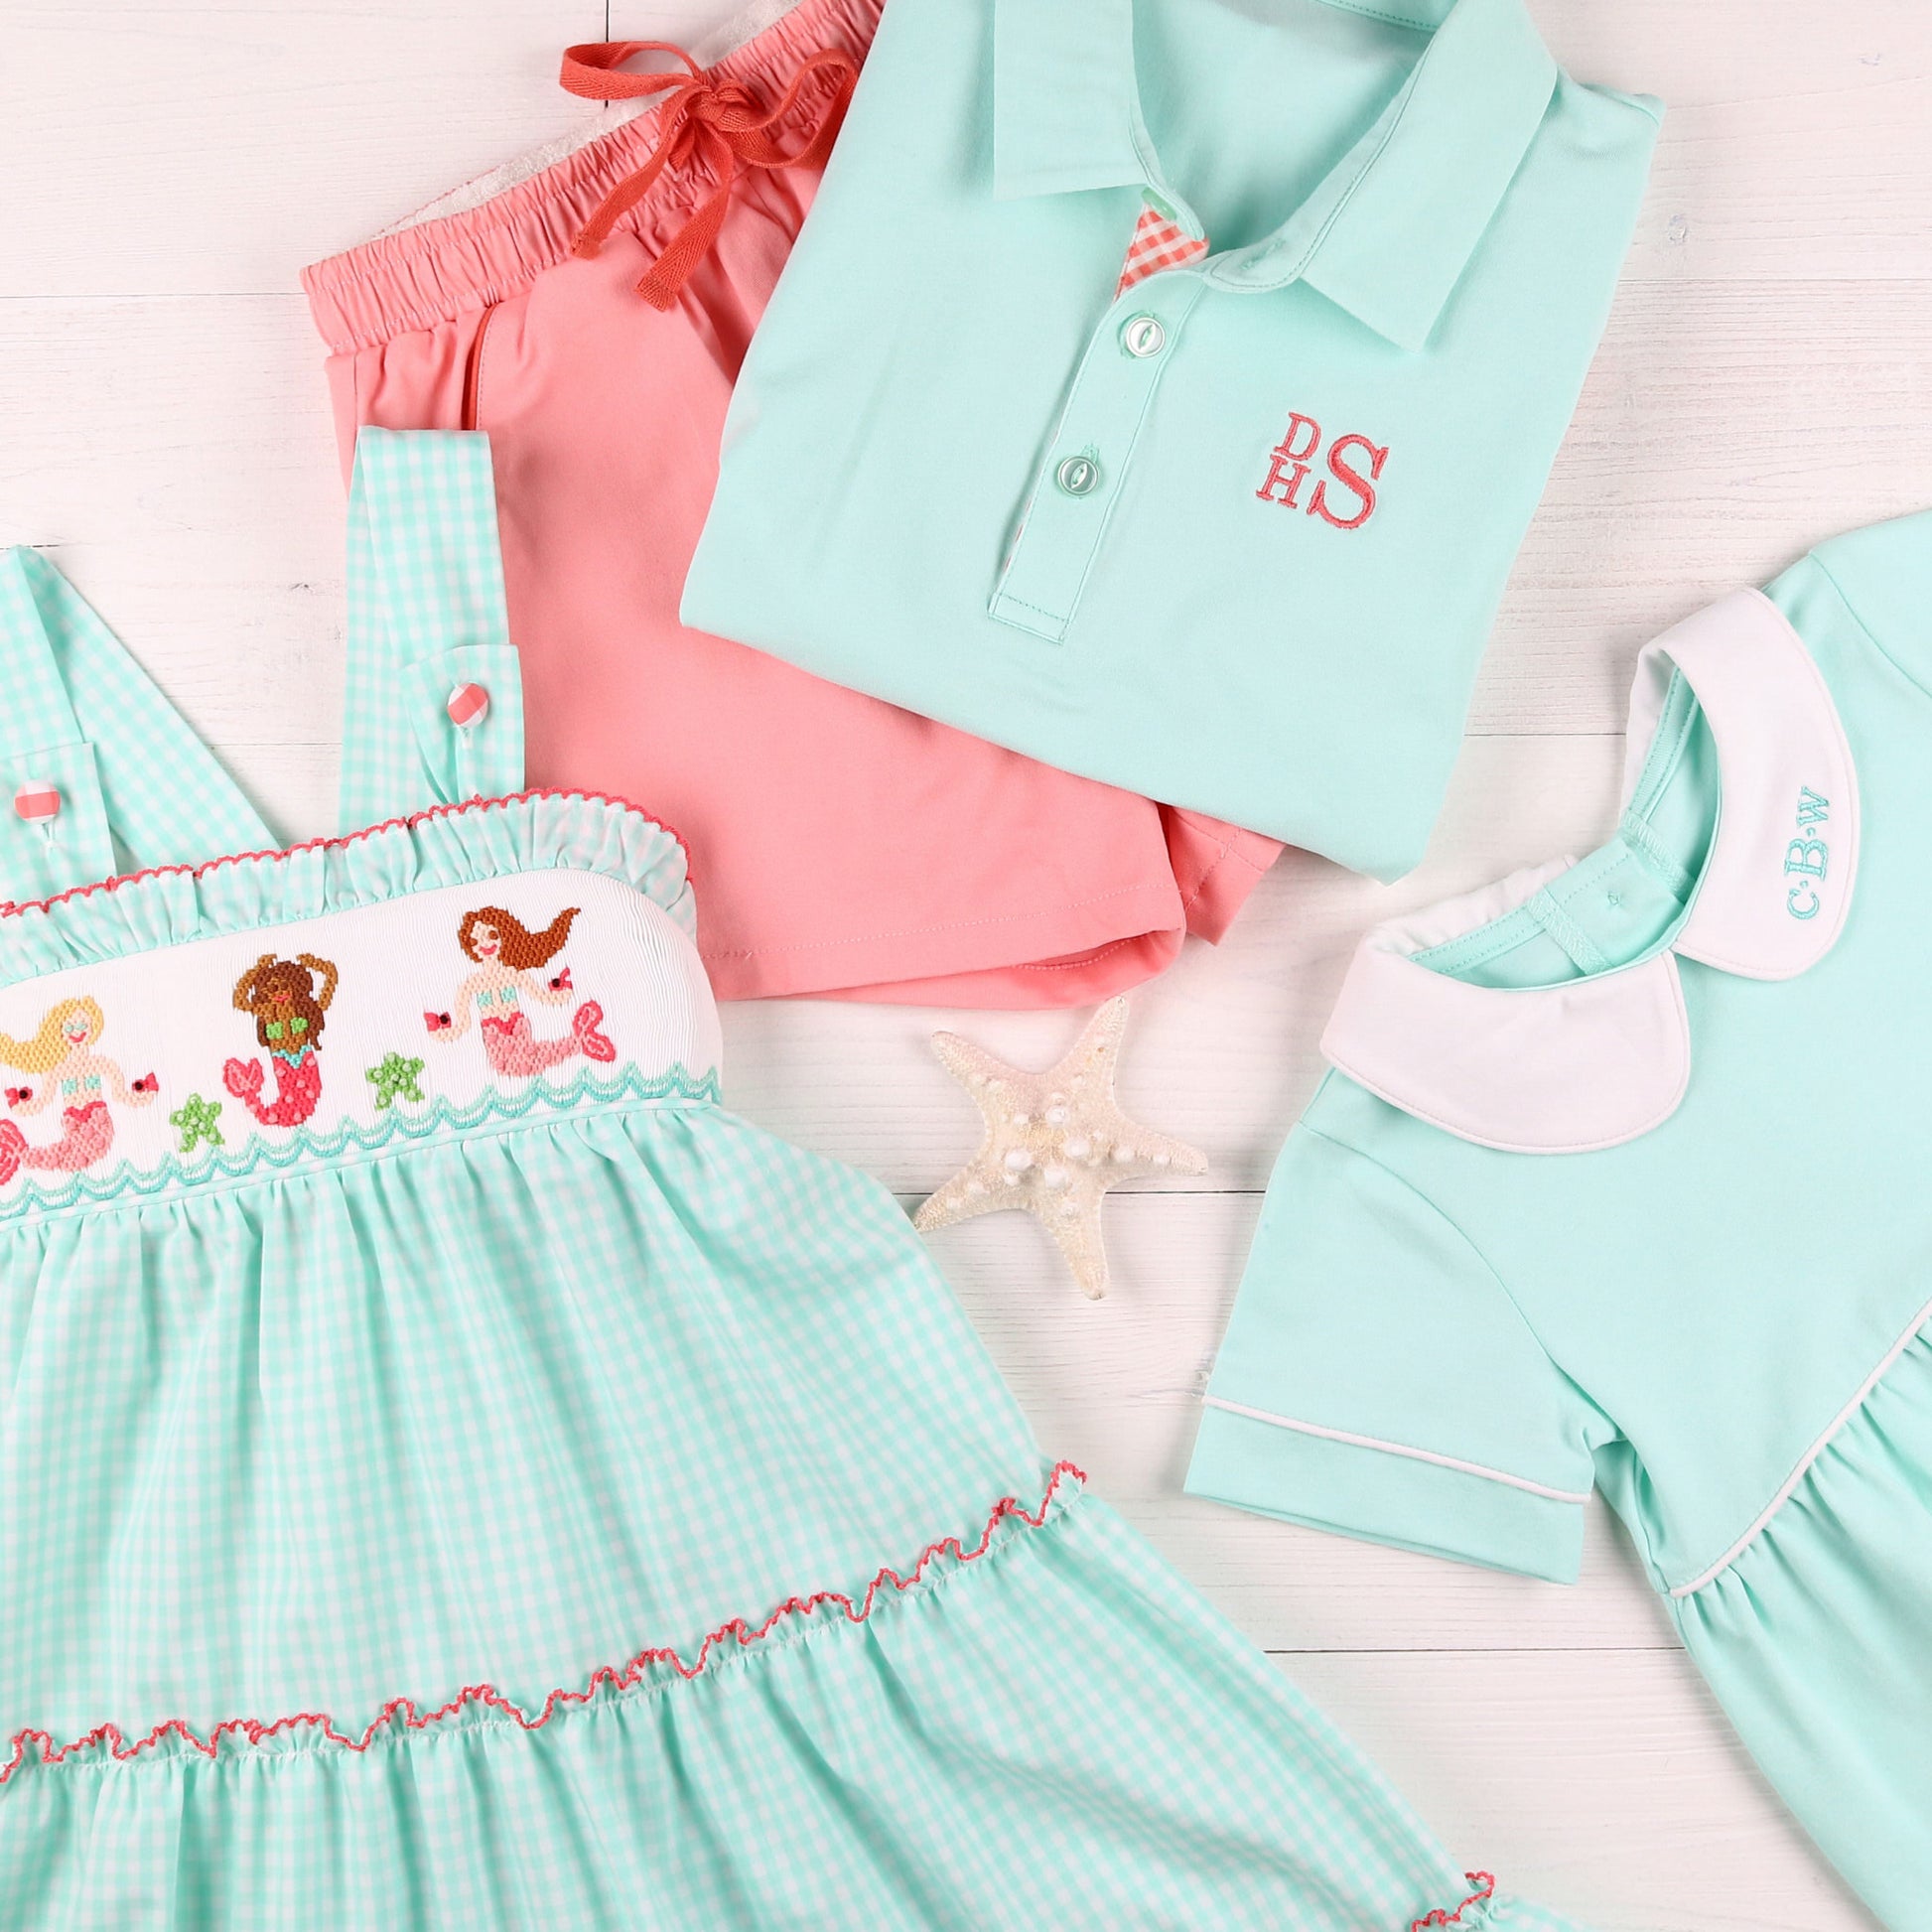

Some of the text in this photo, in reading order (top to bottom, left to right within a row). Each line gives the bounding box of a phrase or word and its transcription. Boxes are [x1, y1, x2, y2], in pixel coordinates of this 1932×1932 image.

[1274, 412, 1321, 461] D
[1256, 454, 1311, 509] H
[1307, 434, 1389, 529] S
